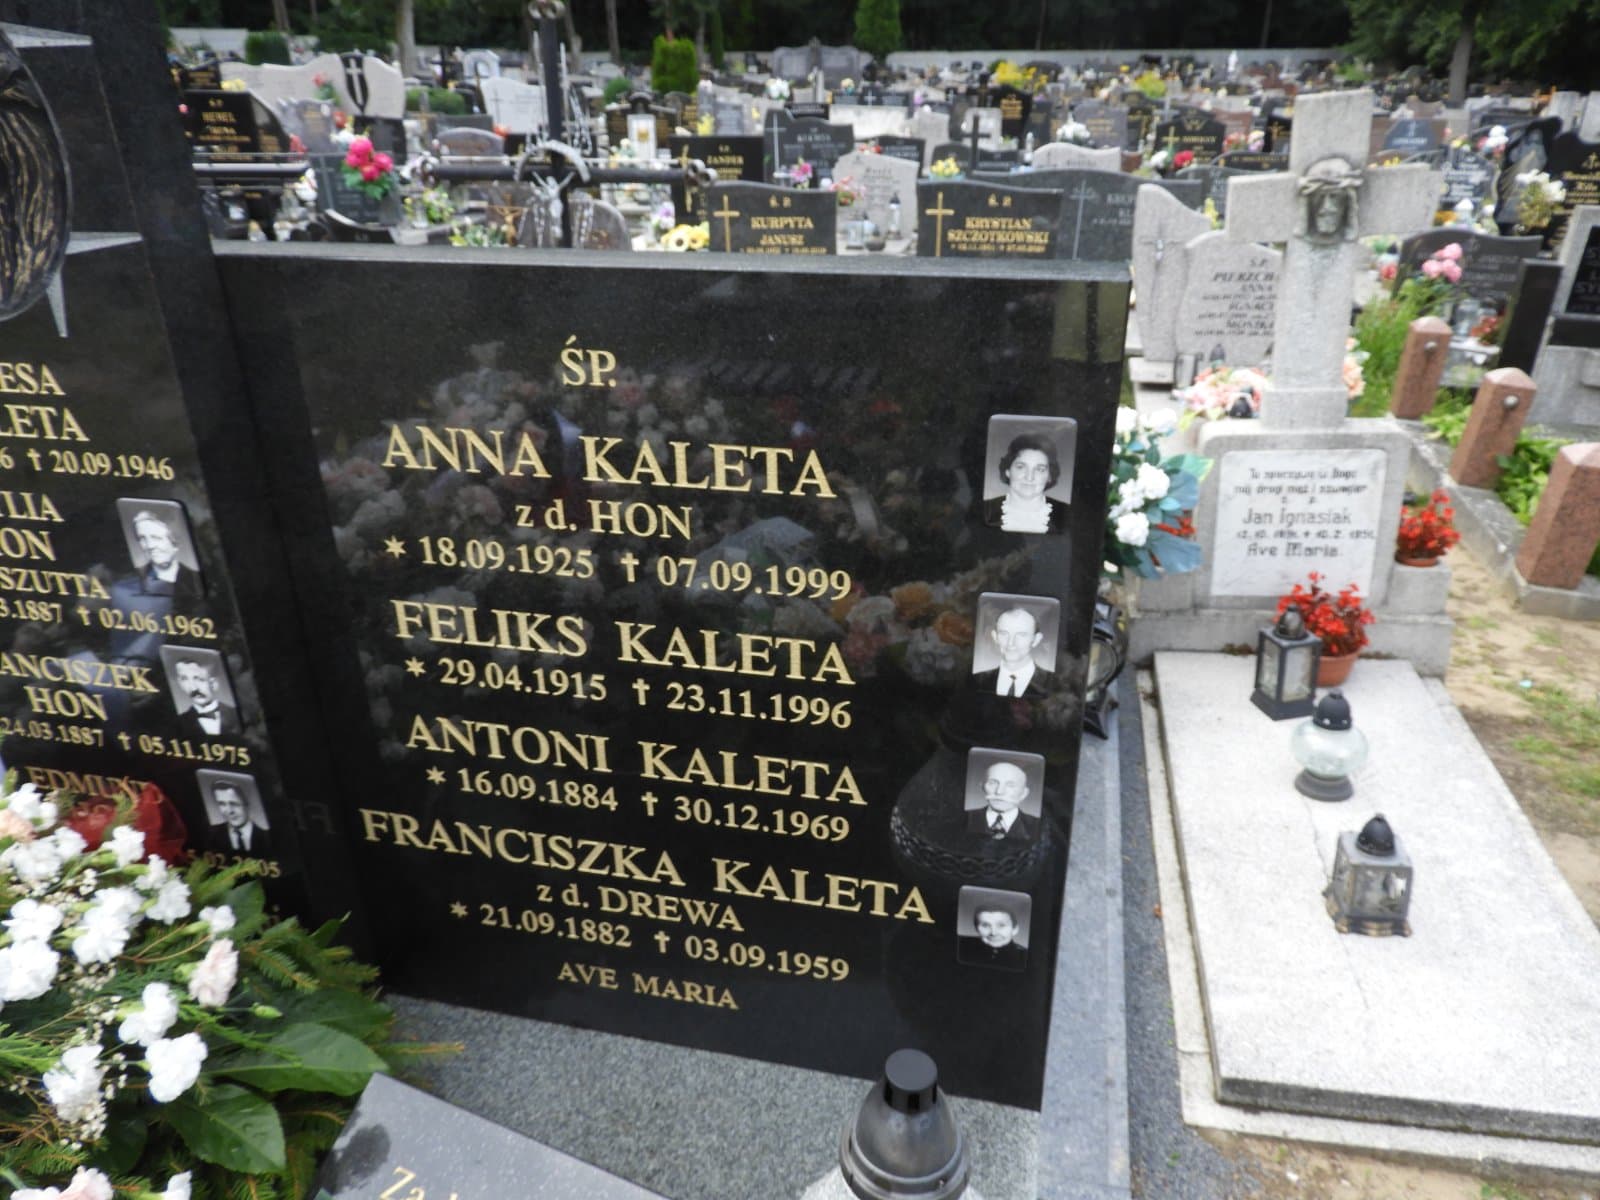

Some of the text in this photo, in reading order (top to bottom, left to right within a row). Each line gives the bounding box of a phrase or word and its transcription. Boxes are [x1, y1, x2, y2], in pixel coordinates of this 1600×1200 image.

[560, 335, 616, 387] ŚP.
[50, 450, 175, 480] 20.09.1946
[381, 424, 837, 498] ANNA KALETA
[0, 491, 64, 522] LIA
[587, 500, 692, 540] HON
[1242, 508, 1352, 528] Jan Ignasiak
[0, 528, 56, 561] ON
[419, 536, 851, 600] 18.09.1925 07.09.1999
[1247, 542, 1278, 557] Ave
[100, 608, 217, 639] 02.06.1962
[390, 599, 856, 685] FELIKS KALETA
[23, 686, 108, 721] HON
[437, 658, 852, 729] 29.04.1915 23.11.1996
[139, 734, 251, 766] 05.11.1975
[406, 714, 868, 805] ANTONI KALETA
[457, 768, 850, 842] 16.09.1884 30.12.1969
[359, 808, 936, 924] FRANCISZKA KALETA
[598, 886, 745, 932] DREWA
[479, 904, 850, 982] 21.09.1882 03.09.1959
[557, 962, 740, 1010] AVE MARIA
